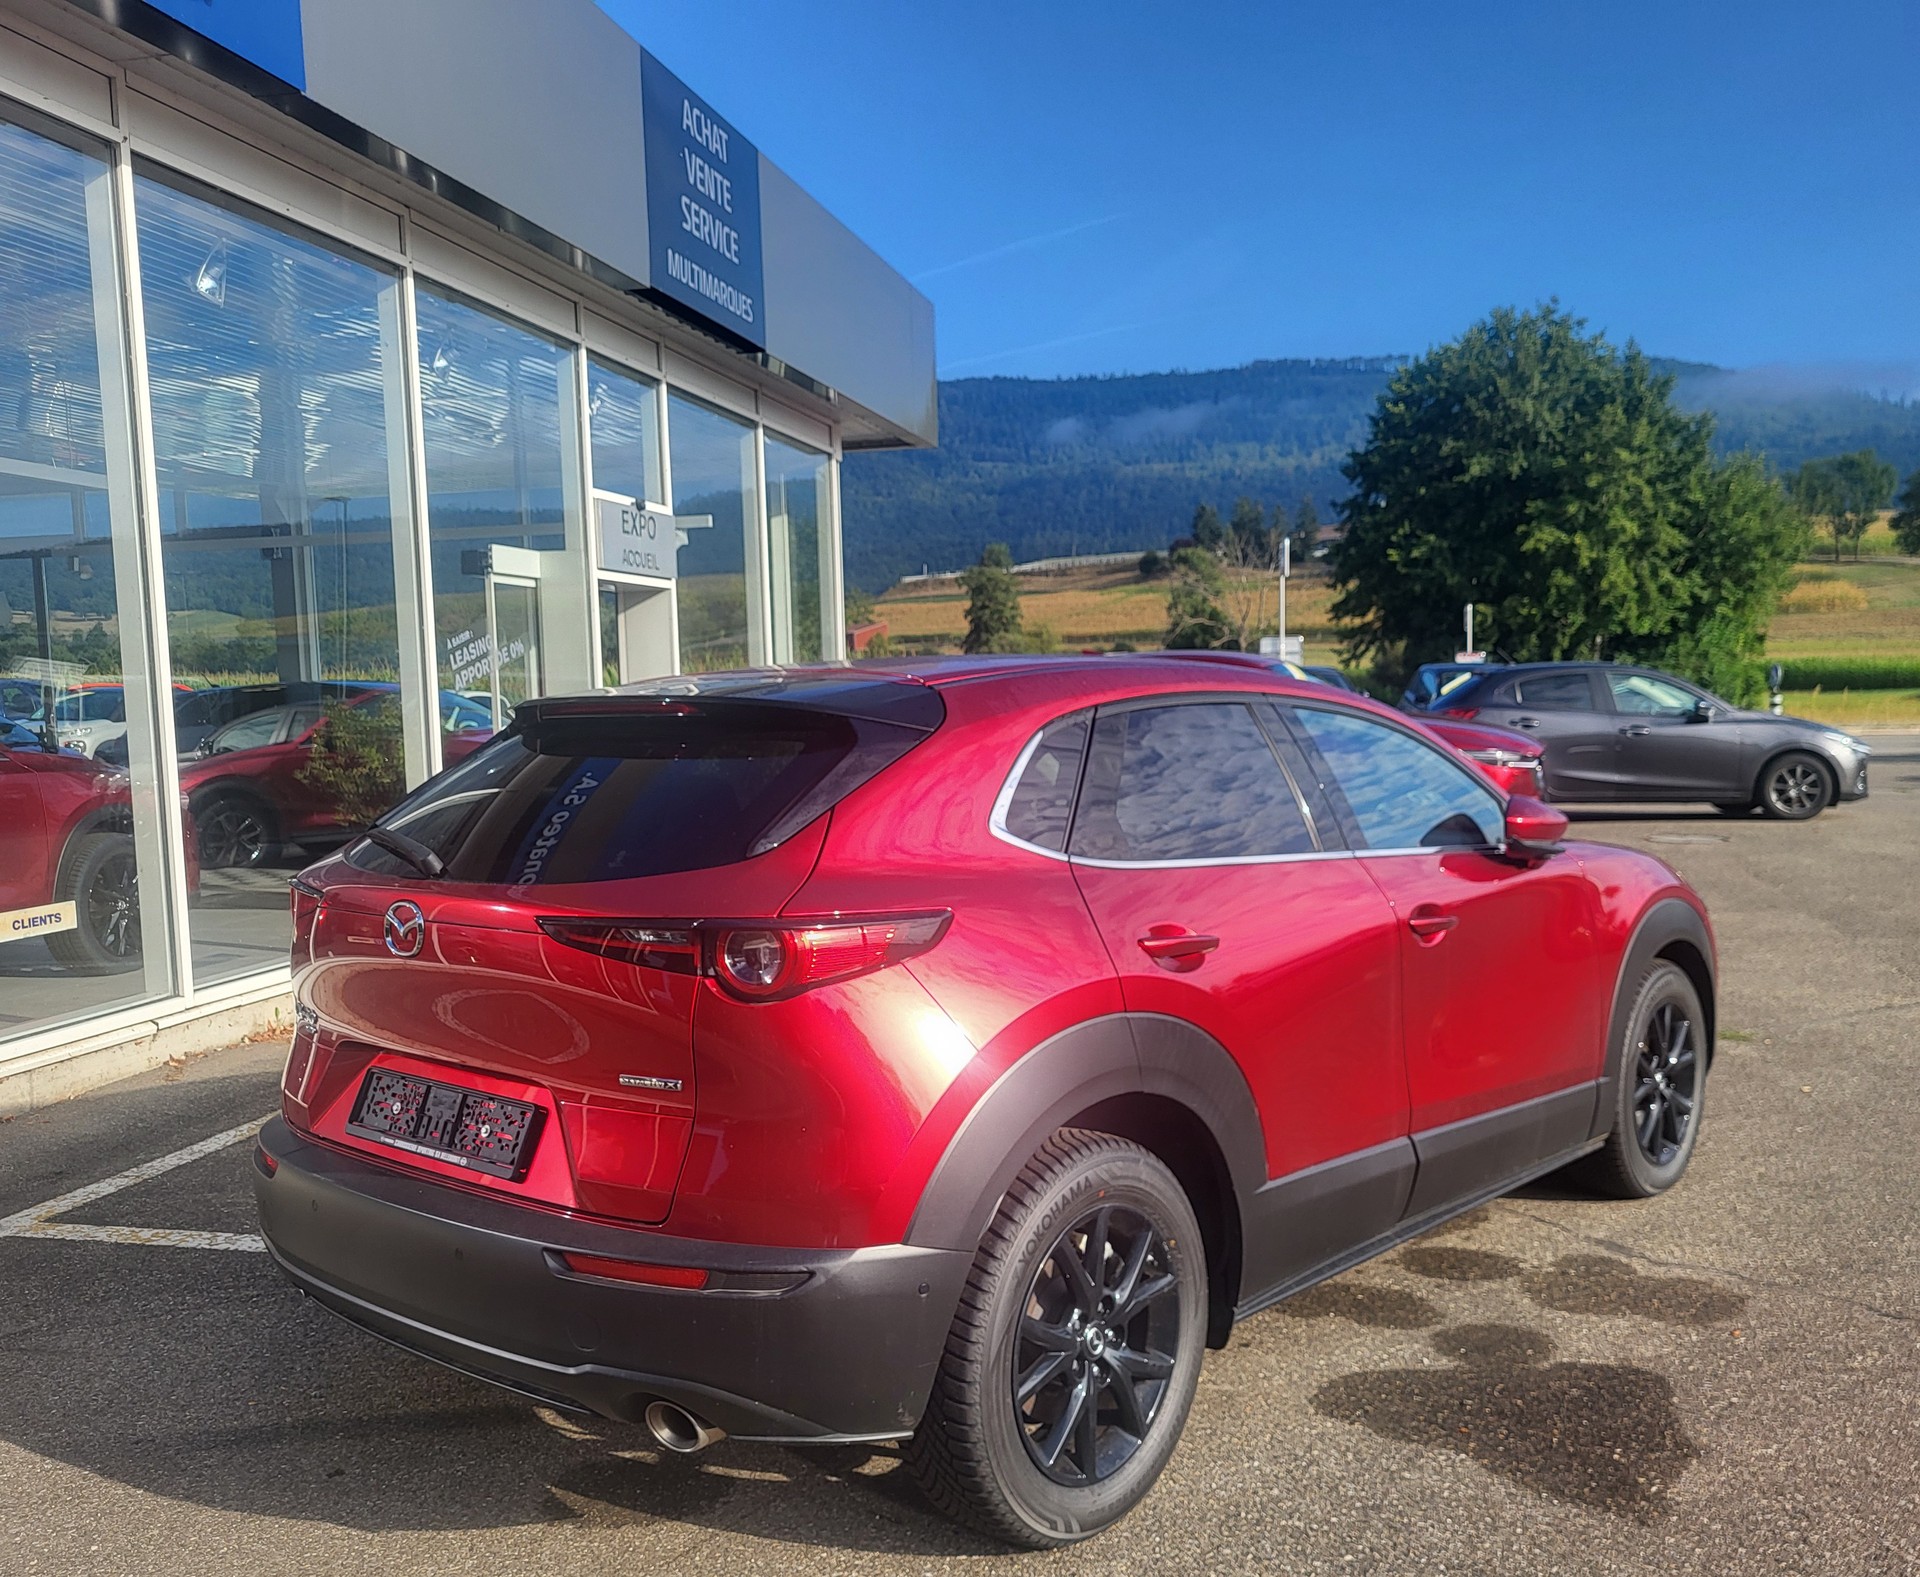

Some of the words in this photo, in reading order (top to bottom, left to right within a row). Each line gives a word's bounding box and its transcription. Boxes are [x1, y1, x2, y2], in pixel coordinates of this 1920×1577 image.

[682, 99, 729, 164] ACHAT
[683, 147, 733, 214] VENTE
[680, 195, 740, 265] SERVICE
[666, 248, 754, 324] MULTIMARQUES
[622, 510, 656, 540] EXPO
[623, 549, 660, 571] ACCUEIL
[450, 634, 493, 671] LEASING
[12, 912, 62, 931] CLIENTS
[1018, 1175, 1094, 1266] YOKOHAMA
